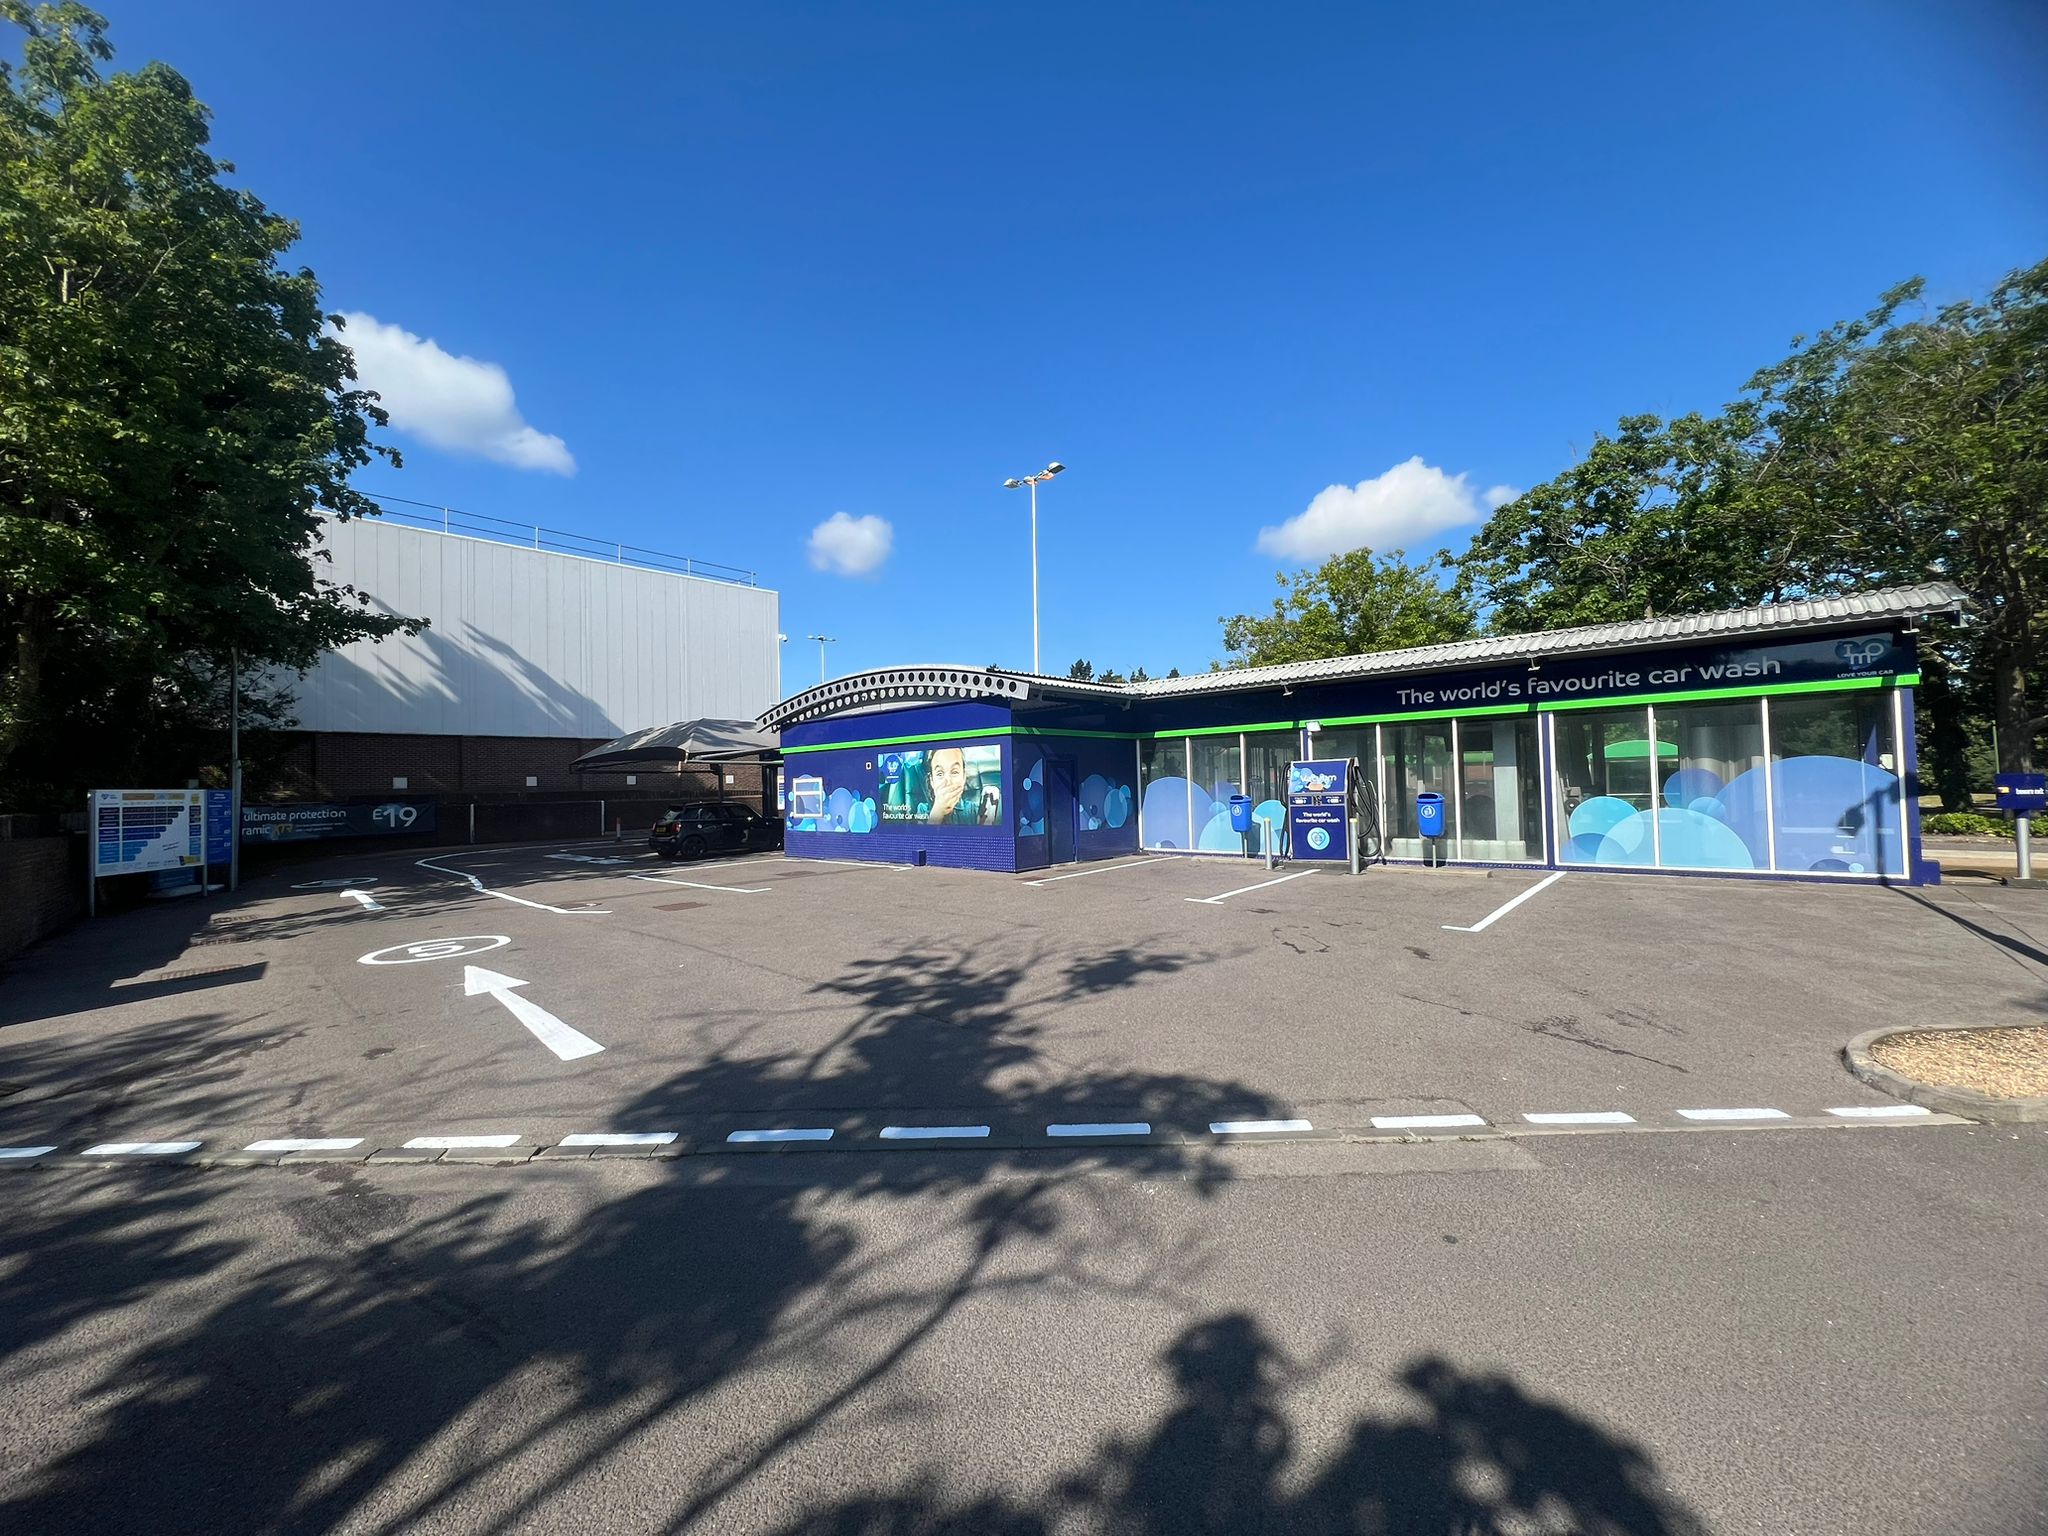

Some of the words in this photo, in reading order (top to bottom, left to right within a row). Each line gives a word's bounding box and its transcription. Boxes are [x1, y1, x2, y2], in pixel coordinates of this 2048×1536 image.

[1396, 689, 1435, 705] The
[1439, 679, 1521, 701] world's
[1527, 670, 1641, 695] favourite
[1648, 667, 1692, 685] car
[1699, 656, 1781, 680] wash
[243, 809, 287, 821] ultimate
[289, 808, 347, 822] protection
[883, 811, 904, 819] favourite
[242, 823, 270, 836] ramic
[407, 942, 465, 958] 5
